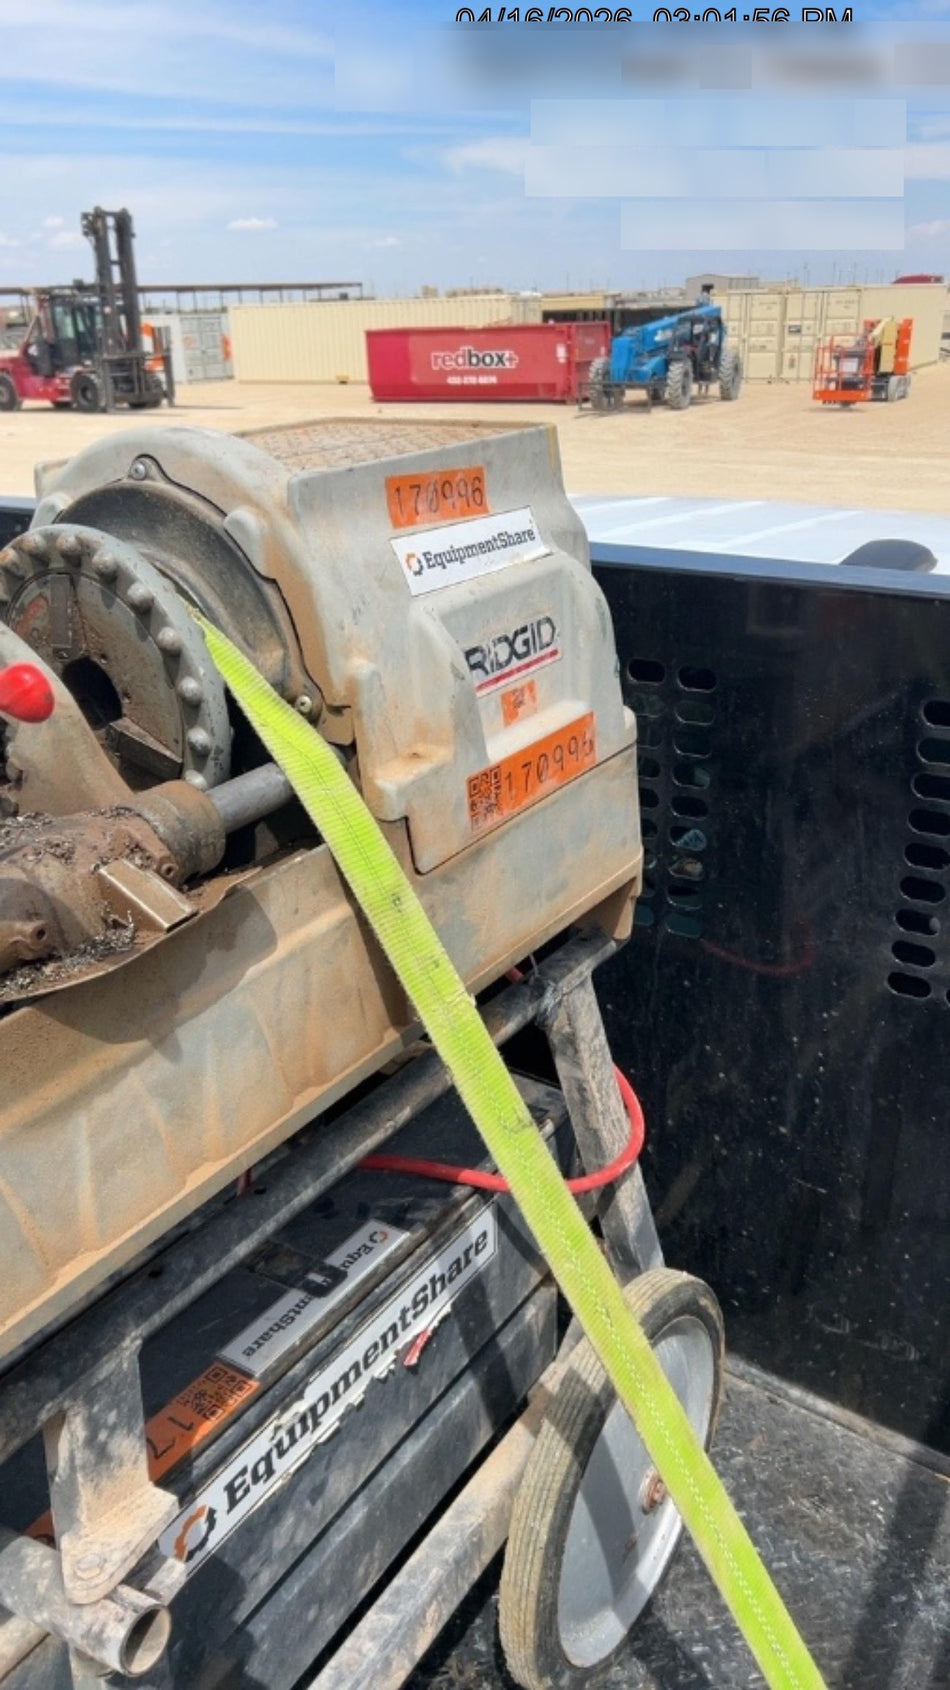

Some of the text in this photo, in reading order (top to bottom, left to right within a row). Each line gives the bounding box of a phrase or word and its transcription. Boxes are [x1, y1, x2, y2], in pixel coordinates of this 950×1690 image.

[395, 476, 484, 516] 170996
[422, 528, 536, 569] EquipmentShare
[465, 616, 556, 676] RIDGID
[223, 1229, 488, 1515] EquipmentShare
